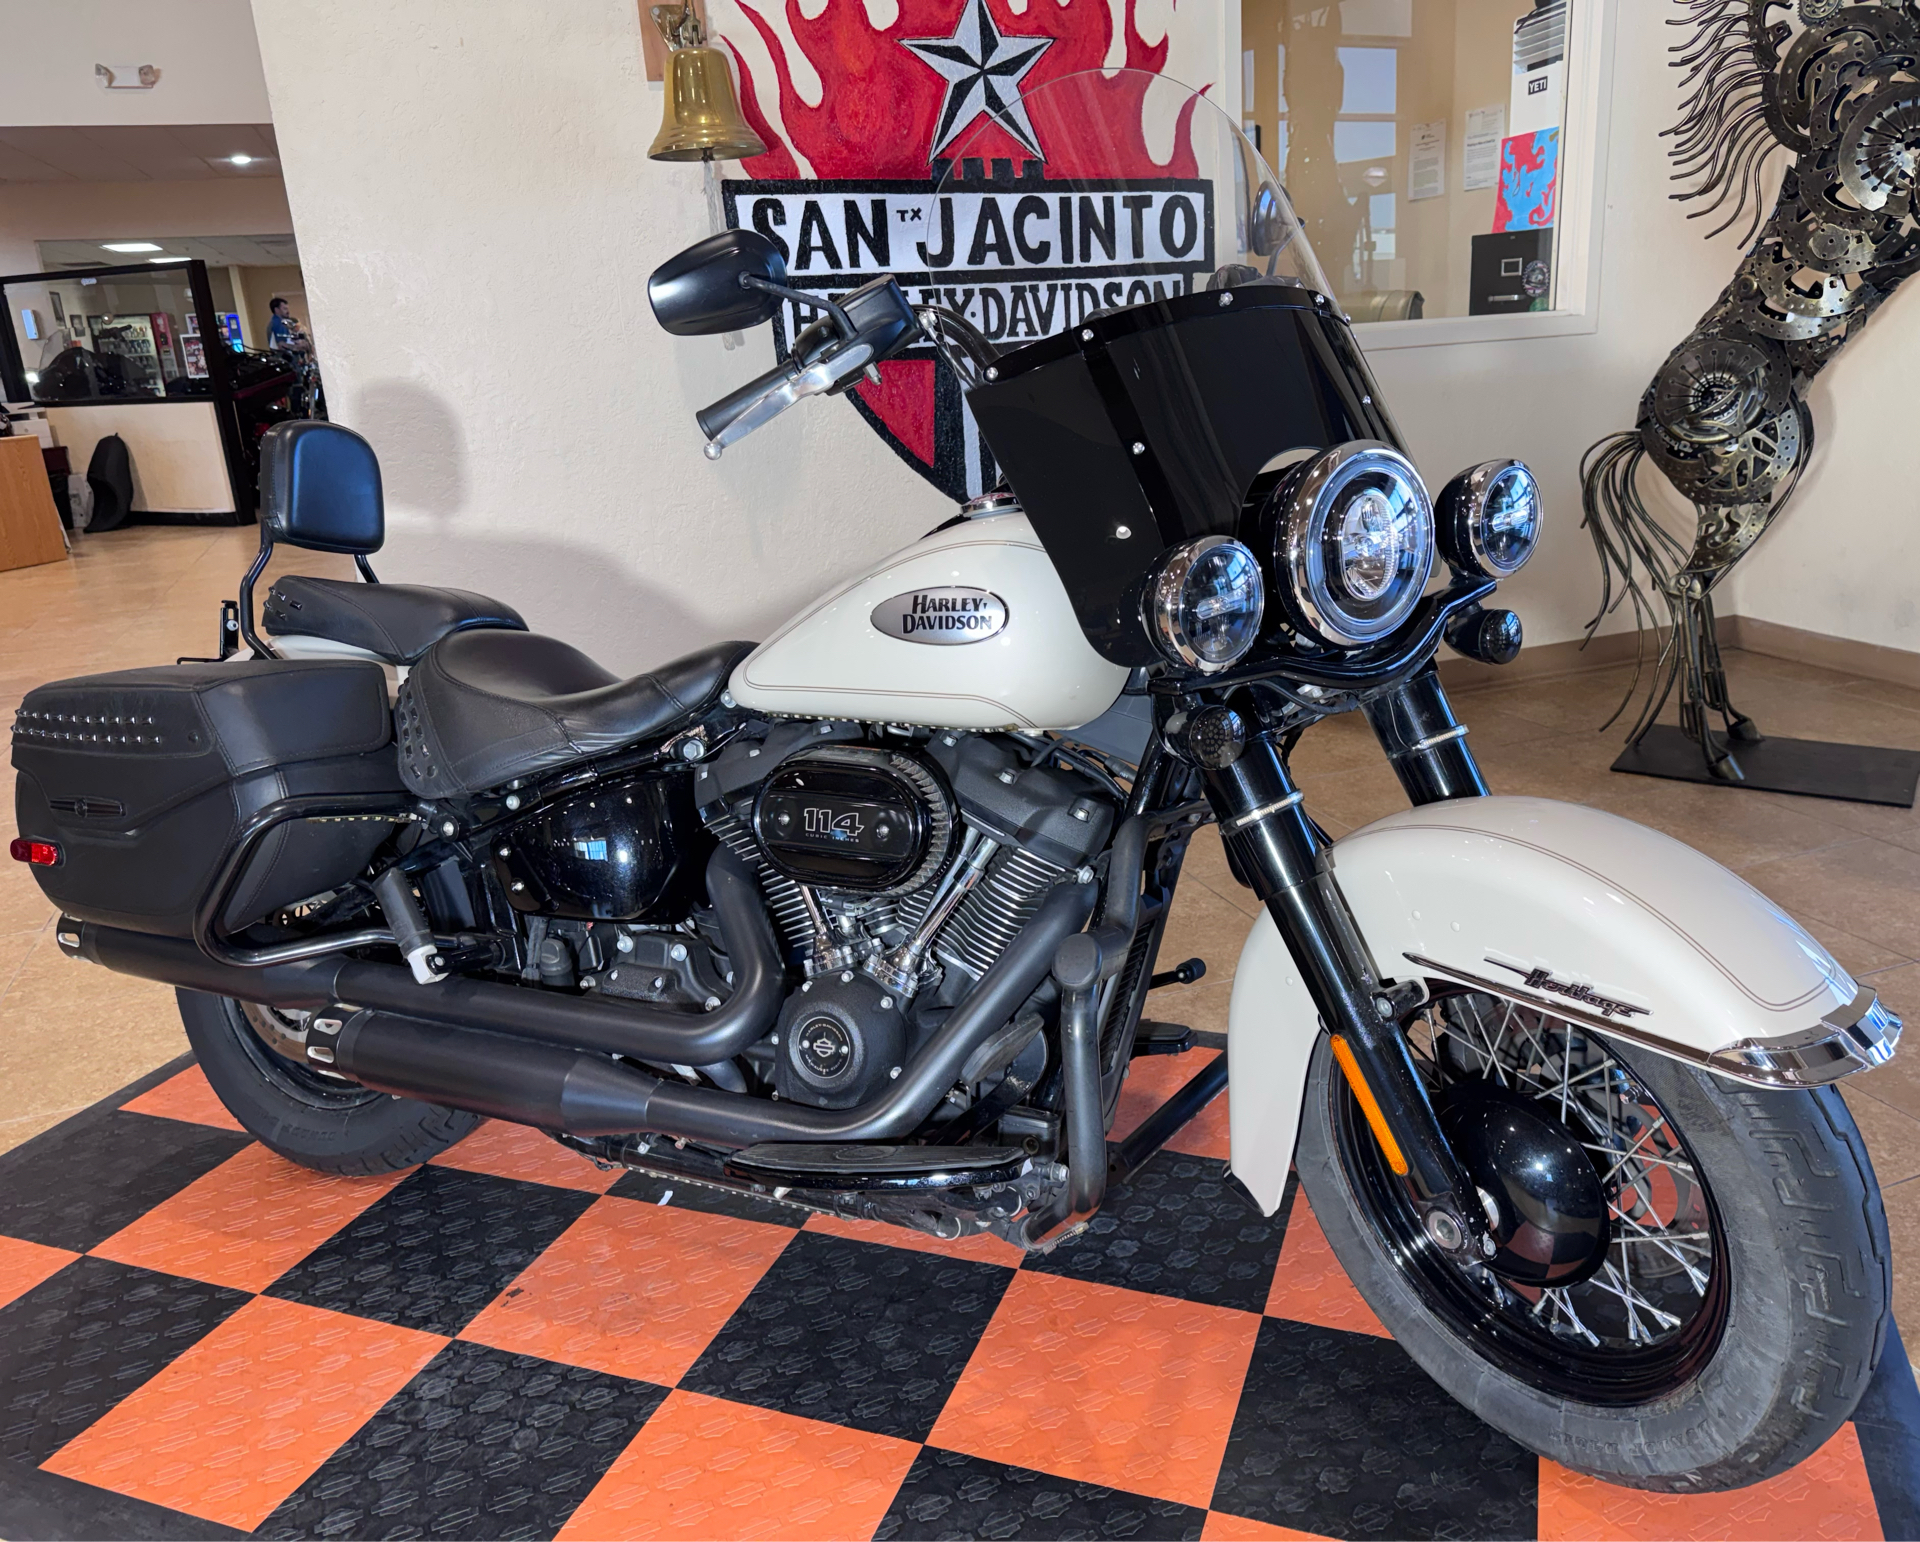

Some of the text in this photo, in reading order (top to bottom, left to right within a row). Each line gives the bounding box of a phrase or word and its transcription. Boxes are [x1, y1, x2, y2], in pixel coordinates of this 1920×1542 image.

[1529, 79, 1547, 93] YETI
[752, 194, 1198, 270] SAN TX JACINTO
[902, 613, 992, 634] DAVIDSON
[804, 807, 865, 837] 114
[805, 832, 828, 840] CUBIC
